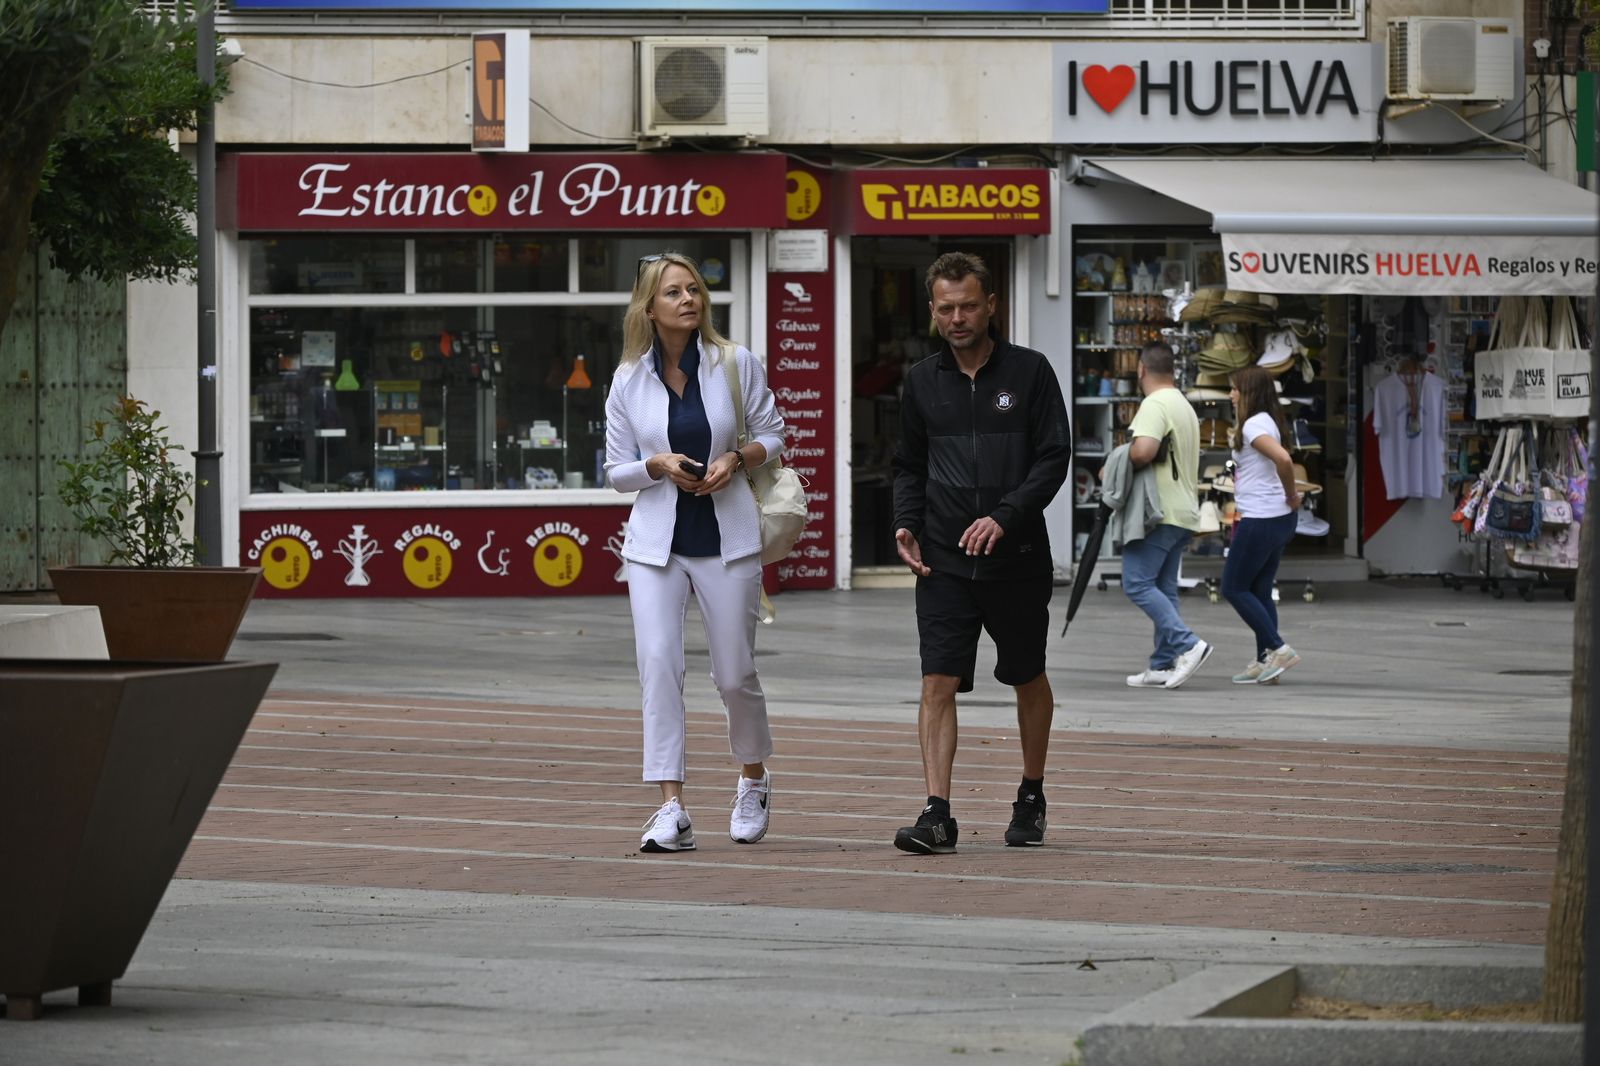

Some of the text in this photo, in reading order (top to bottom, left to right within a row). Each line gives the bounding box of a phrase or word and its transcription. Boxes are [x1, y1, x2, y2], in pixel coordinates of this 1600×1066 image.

[1068, 60, 1360, 116] I HUELVA
[508, 170, 544, 216] el
[904, 184, 1040, 208] TABACOS
[1228, 252, 1370, 275] SOUVENIRS
[1376, 252, 1482, 276] HUELVA
[1488, 257, 1555, 277] Regalos
[1559, 260, 1570, 277] y
[775, 319, 821, 332] Tabacos
[780, 338, 817, 351] Puros
[1524, 368, 1545, 377] HUE
[1524, 377, 1546, 387] LVA
[1561, 377, 1572, 386] HU
[775, 387, 821, 403] Regalos
[1482, 388, 1502, 398] HUEL
[248, 523, 323, 560] CACHIMBAS
[393, 523, 462, 552] REGALOS
[525, 521, 589, 548] BEBIDAS
